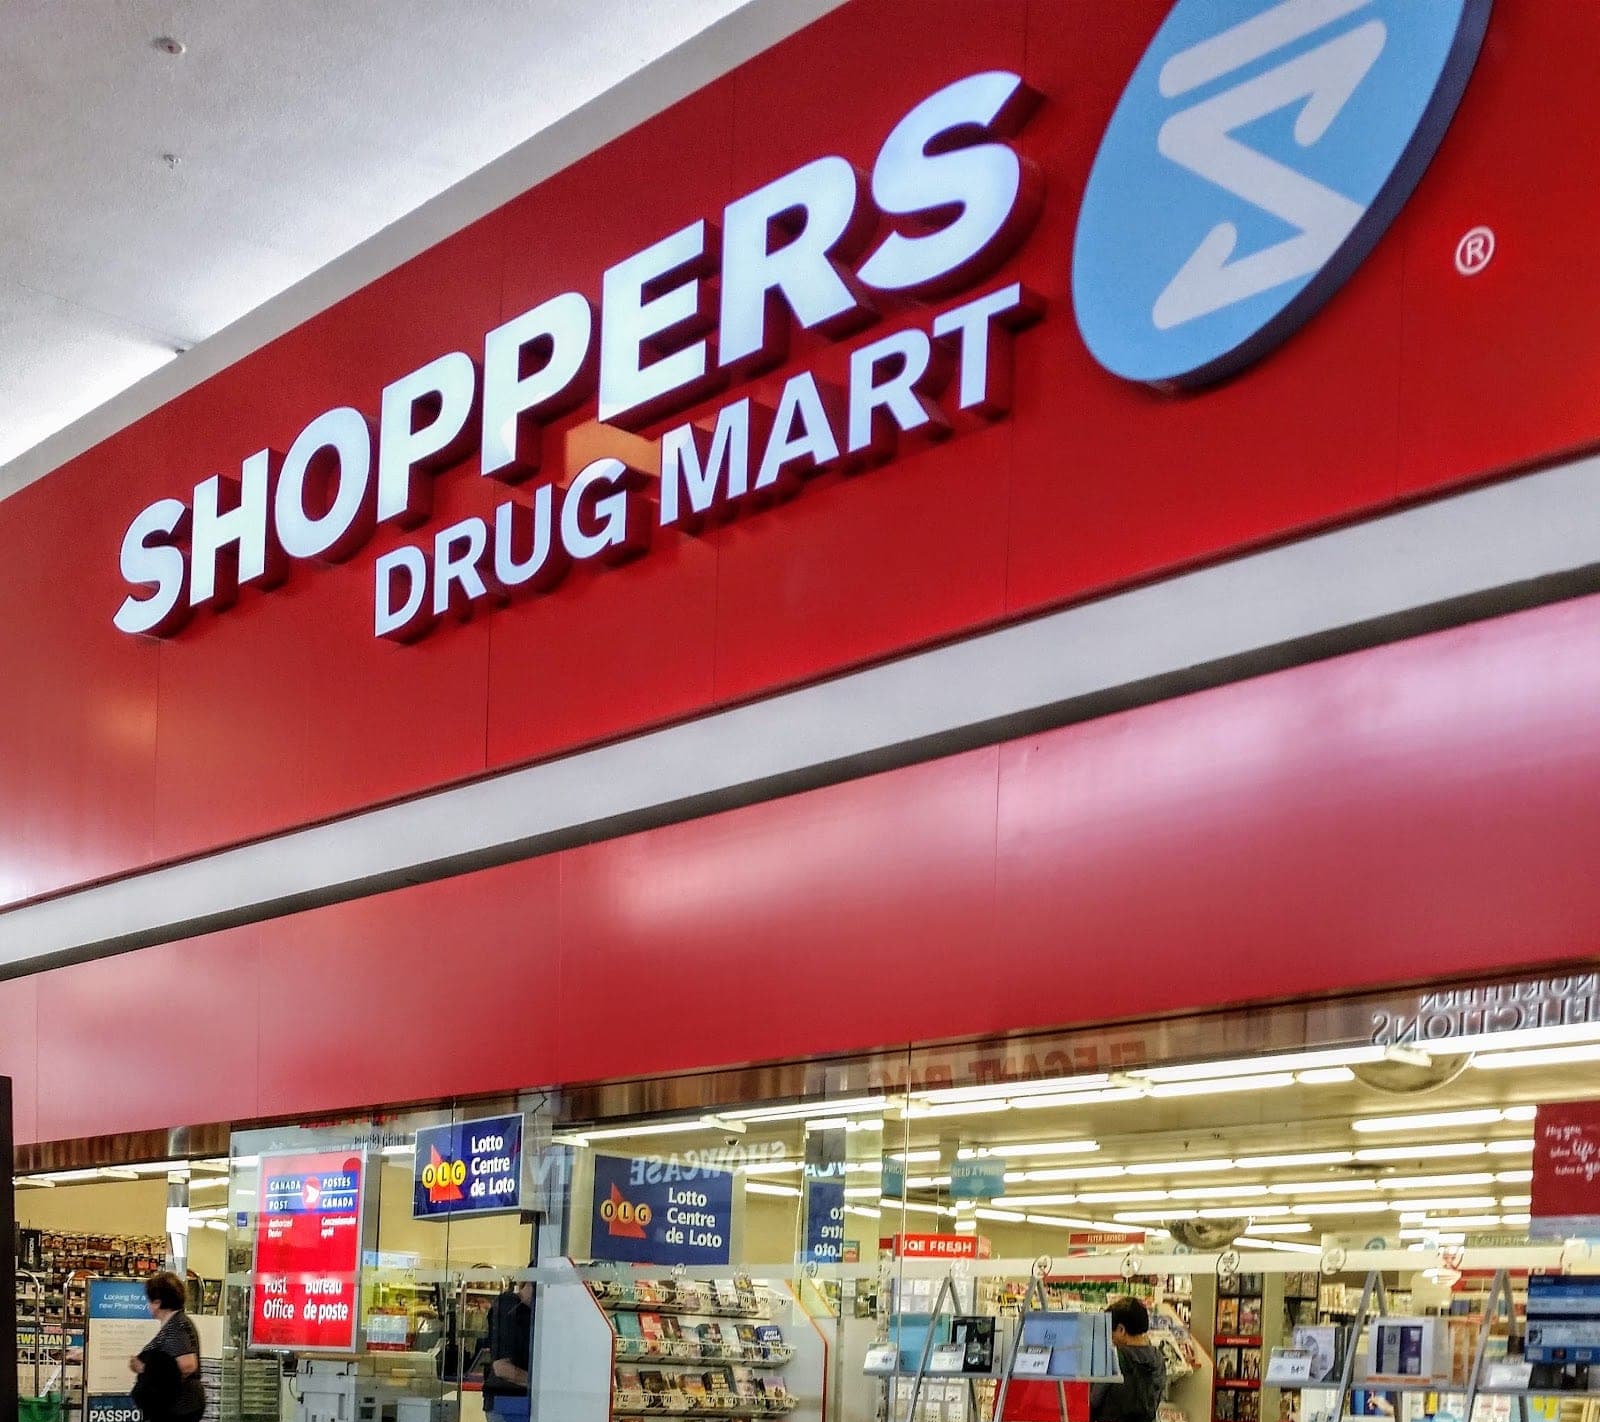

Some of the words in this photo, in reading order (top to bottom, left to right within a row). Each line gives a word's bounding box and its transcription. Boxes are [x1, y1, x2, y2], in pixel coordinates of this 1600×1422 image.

[113, 69, 1026, 637] SHOPPERS
[373, 457, 634, 640] DRUG
[658, 283, 1024, 526] MART
[471, 1135, 504, 1154] Lotto
[424, 1164, 464, 1187] OLG
[471, 1156, 511, 1175] Centre
[270, 1180, 301, 1191] CANADA
[323, 1177, 351, 1188] POSTES
[470, 1178, 486, 1197] de
[489, 1176, 515, 1194] Loto
[269, 1200, 288, 1210] POST
[322, 1197, 353, 1208] CANADA
[668, 1187, 707, 1207] Lotto
[602, 1201, 650, 1223] OLG
[667, 1208, 716, 1228] Centre
[665, 1226, 683, 1244] de
[689, 1229, 722, 1248] Loto
[903, 1238, 925, 1251] JOE
[929, 1240, 972, 1253] FRESH
[103, 1294, 129, 1302] Looking
[263, 1299, 294, 1319] Office
[303, 1299, 317, 1320] de
[318, 1303, 348, 1325] poste
[17, 1333, 72, 1346] EWSSTAND
[89, 1409, 141, 1422] PASSPO
